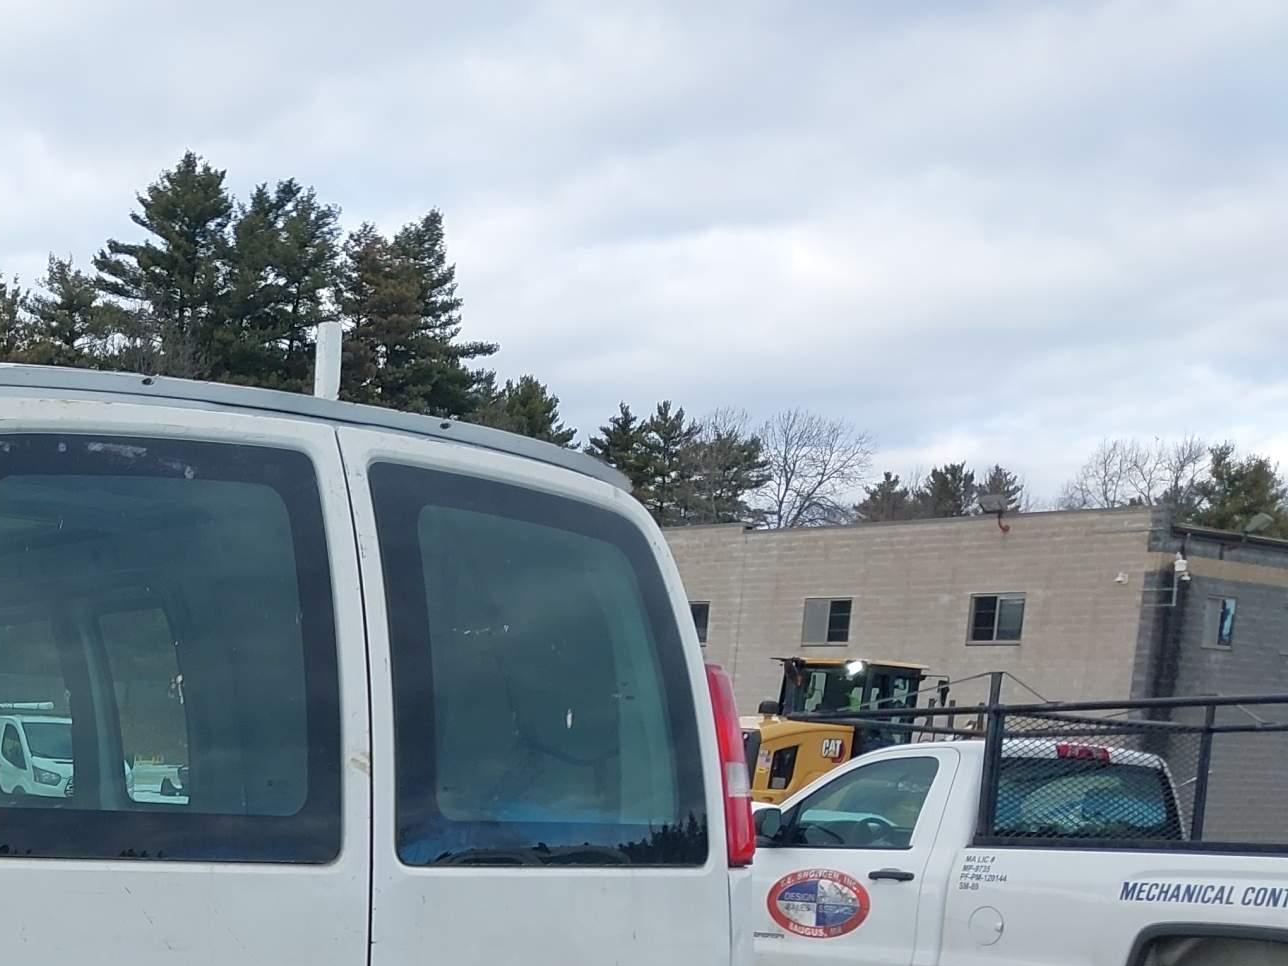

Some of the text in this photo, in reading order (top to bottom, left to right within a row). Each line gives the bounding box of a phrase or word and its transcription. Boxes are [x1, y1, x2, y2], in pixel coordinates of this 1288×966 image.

[822, 739, 842, 757] CAT
[784, 892, 816, 902] DESIGN
[1119, 881, 1235, 906] MECHANICAL
